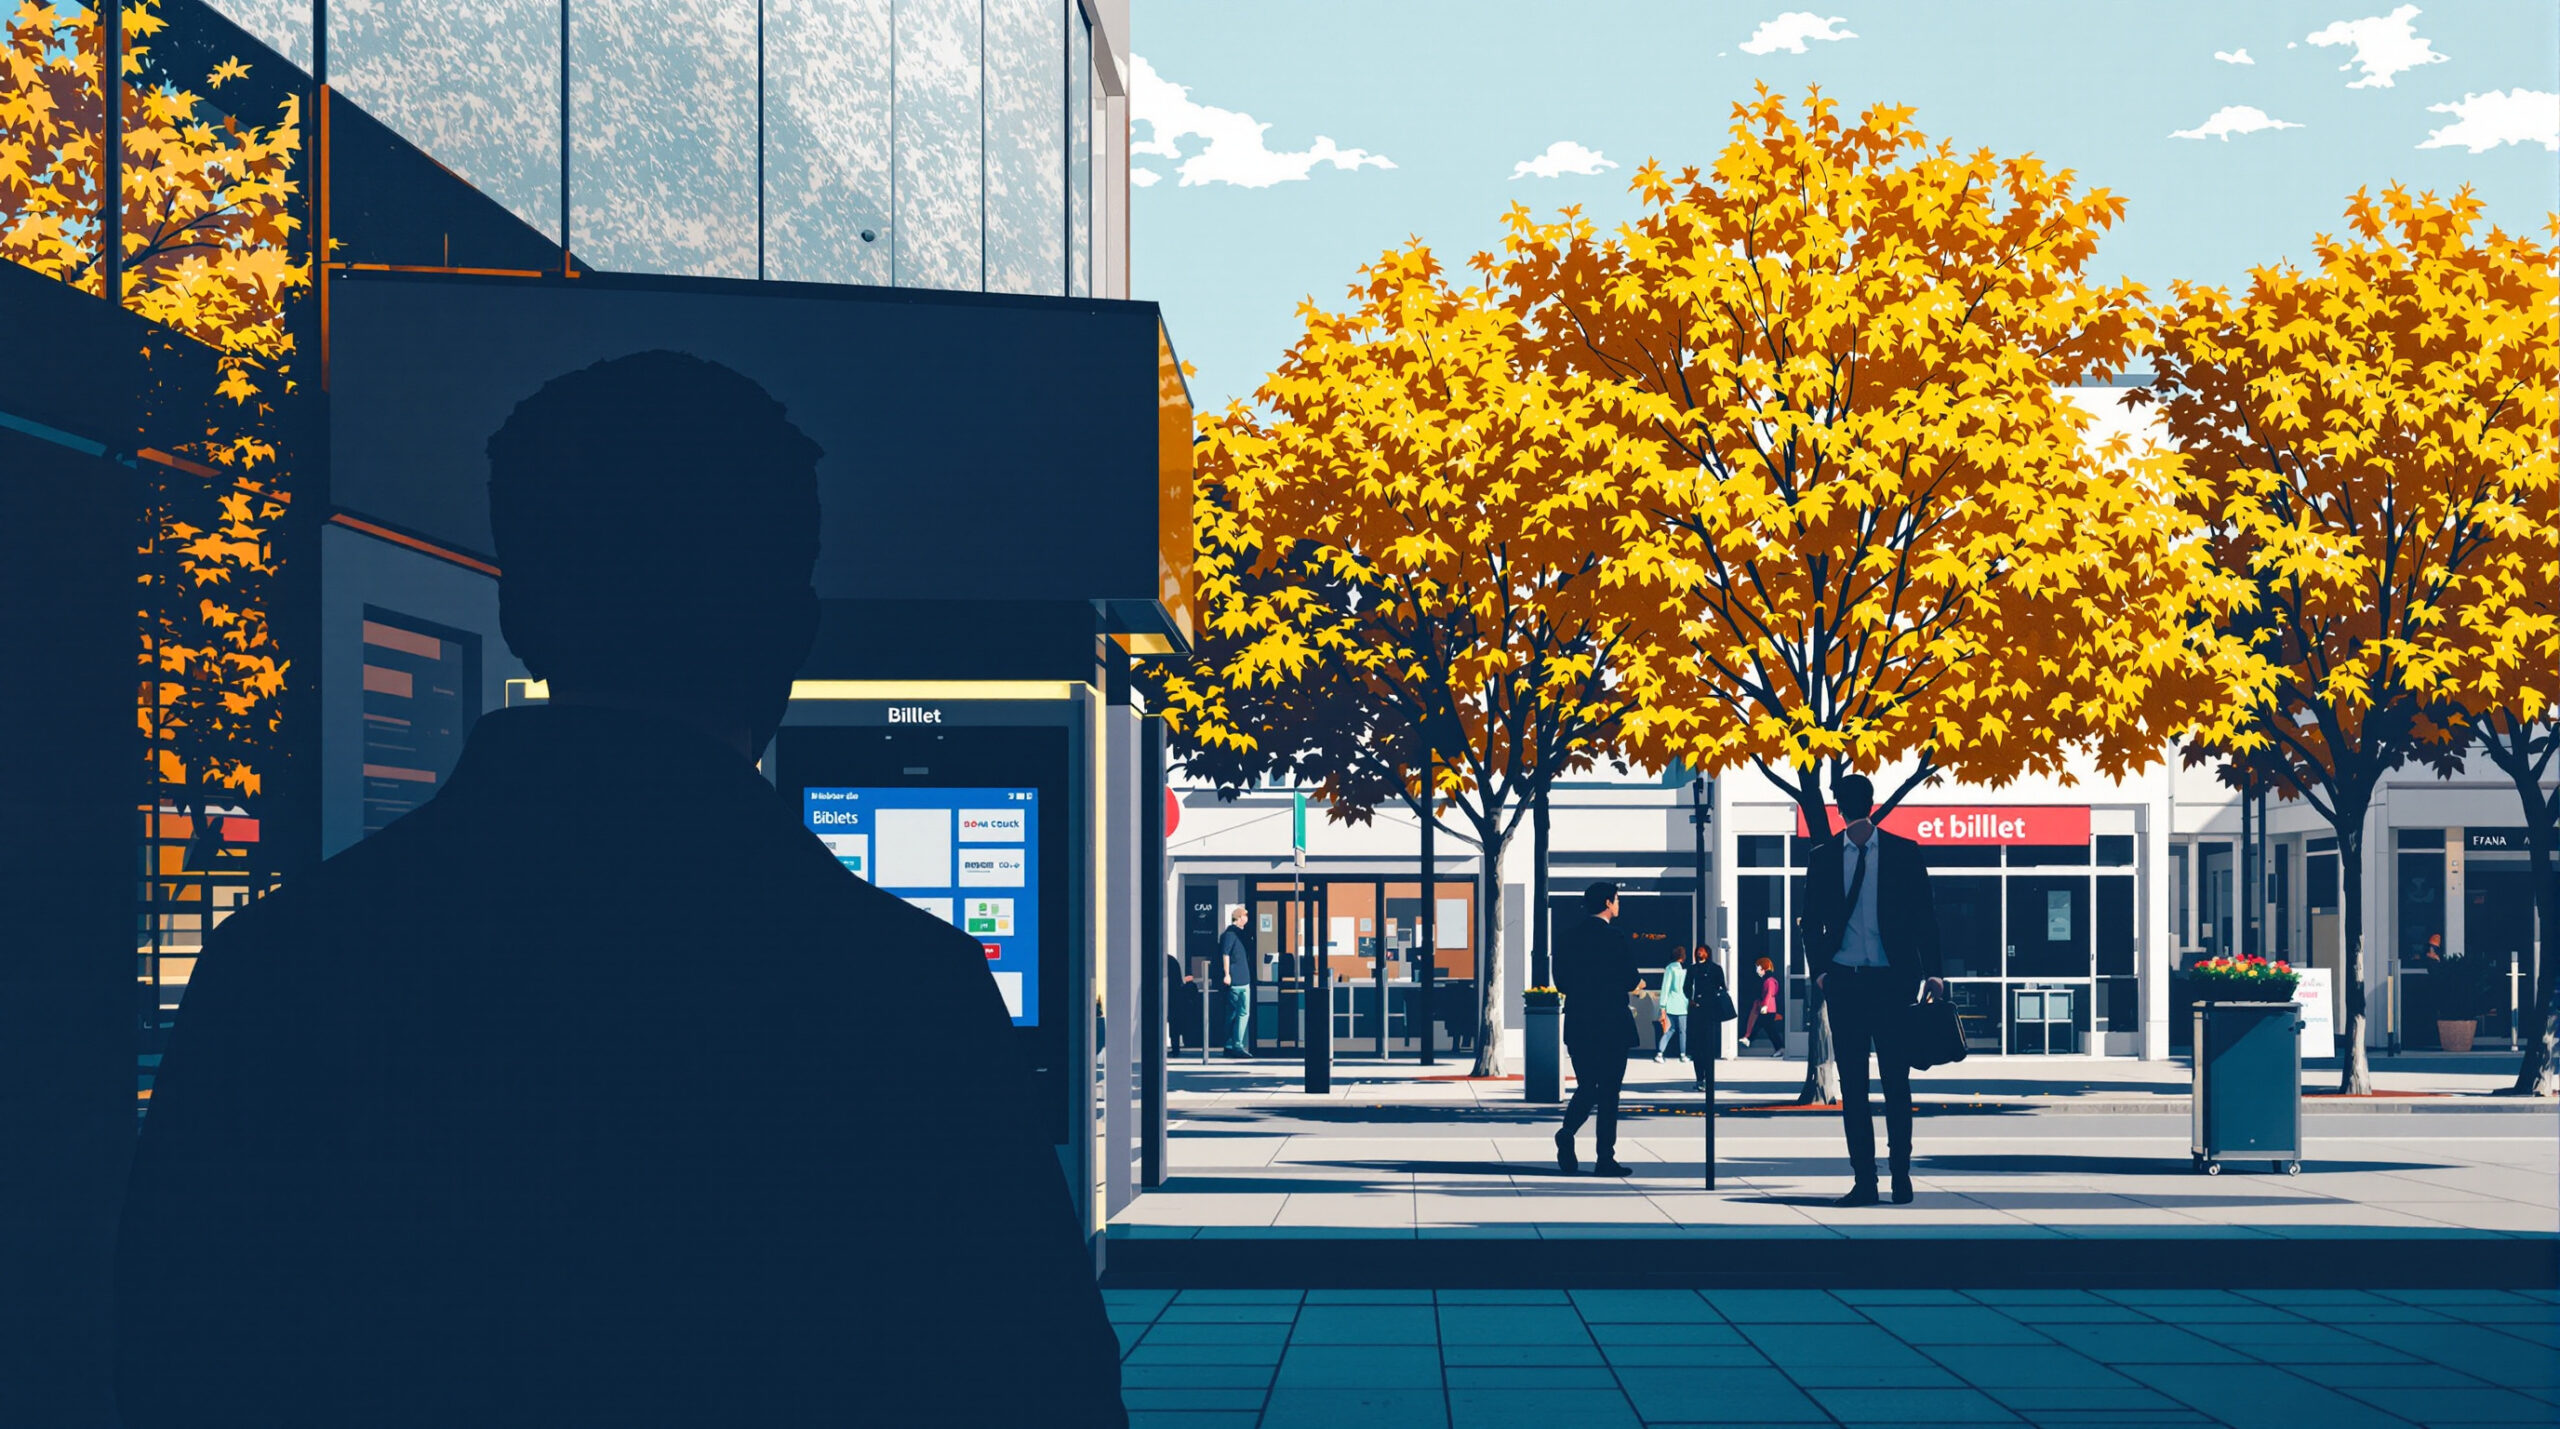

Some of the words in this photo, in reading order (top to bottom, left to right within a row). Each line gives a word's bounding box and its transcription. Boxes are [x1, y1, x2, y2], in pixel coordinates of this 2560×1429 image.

[888, 707, 942, 723] Billlet
[813, 810, 859, 825] Biblets
[1917, 817, 1945, 838] et
[1949, 814, 2026, 838] billlet
